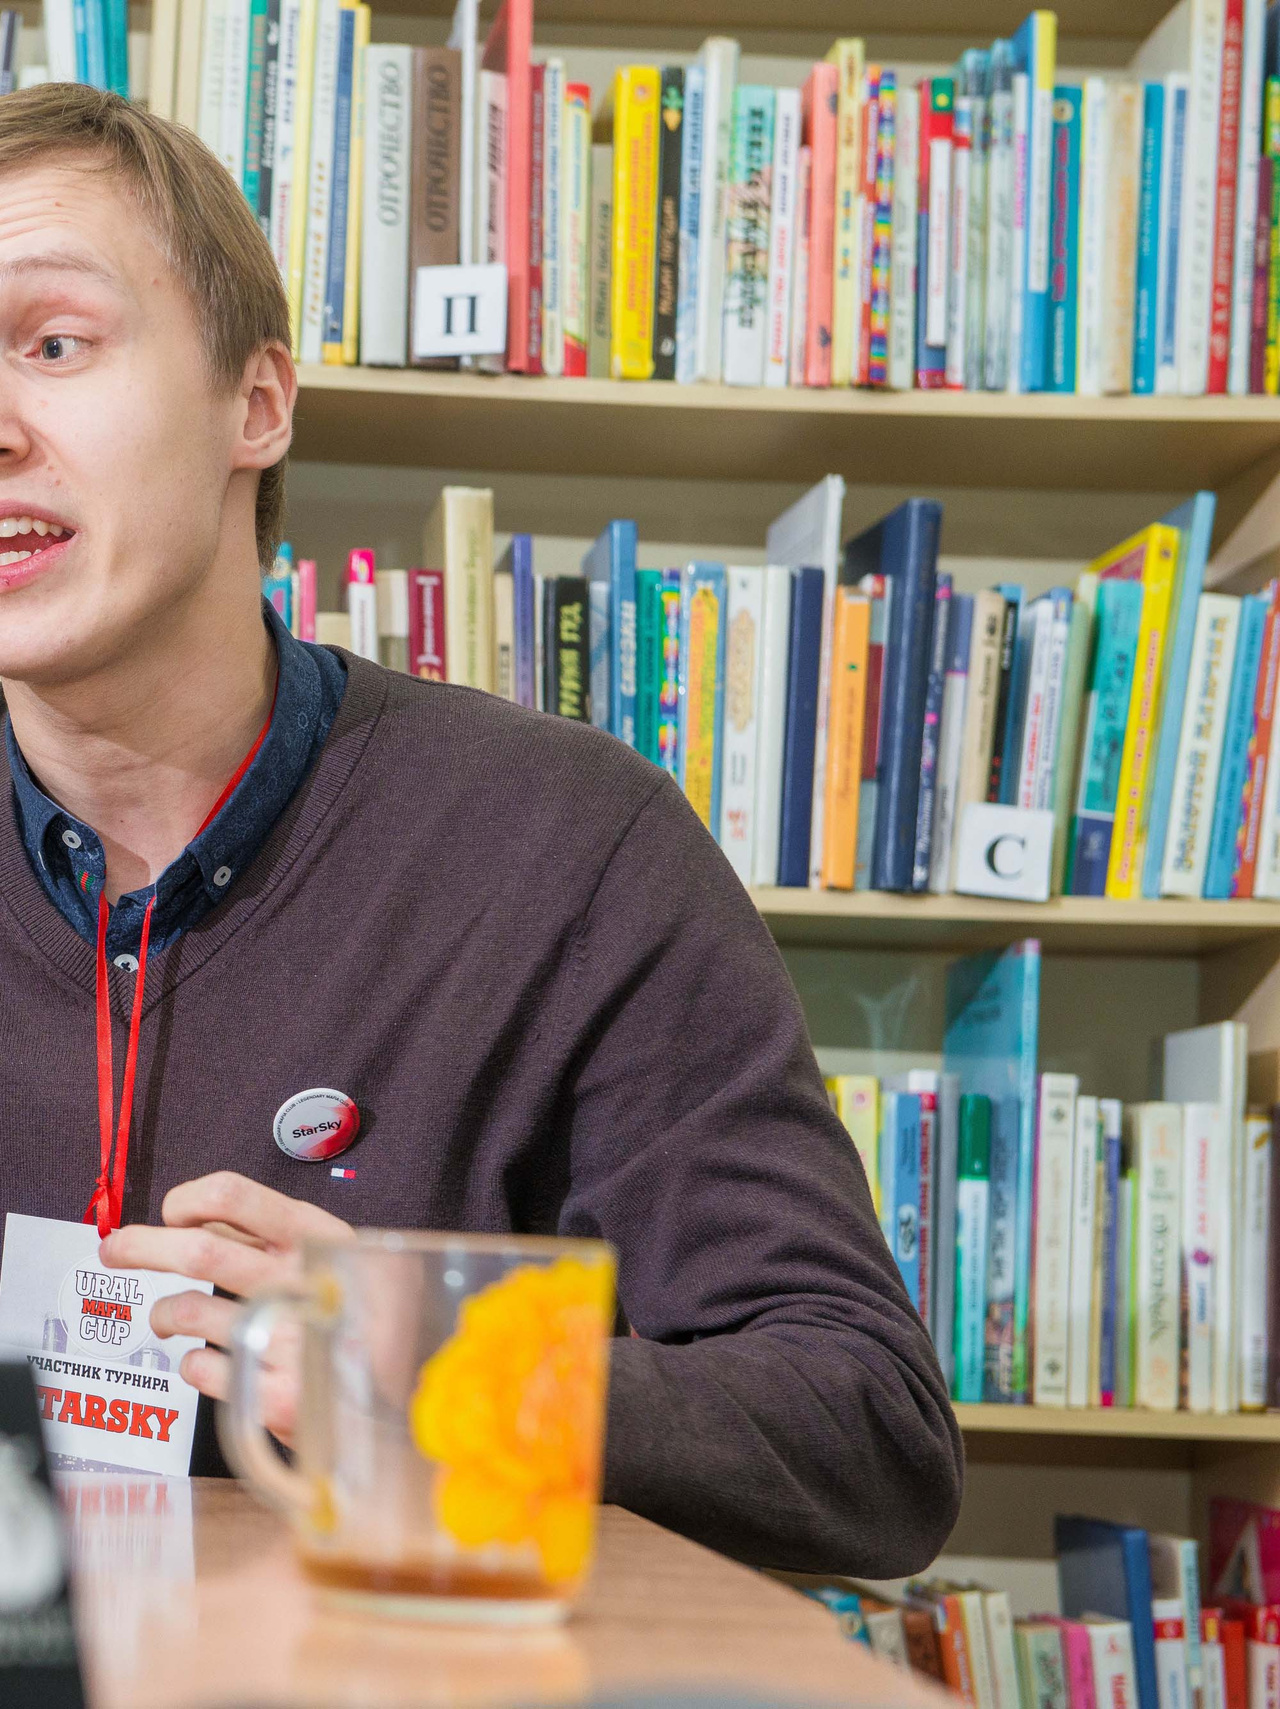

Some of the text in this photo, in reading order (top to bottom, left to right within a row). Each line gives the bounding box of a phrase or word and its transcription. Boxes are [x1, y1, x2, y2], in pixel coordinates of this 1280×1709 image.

[377, 60, 404, 228] ОТРОЧЕСТВО
[425, 65, 452, 232] ОТРОЧЕСТВО
[443, 295, 478, 336] П
[292, 1120, 342, 1139] StarSky
[75, 1270, 144, 1305] URAL
[82, 1298, 132, 1322] MAFIA
[80, 1317, 131, 1346] CUP
[105, 1369, 170, 1393] ТУРНИРА
[34, 1385, 179, 1443] TARSKY
